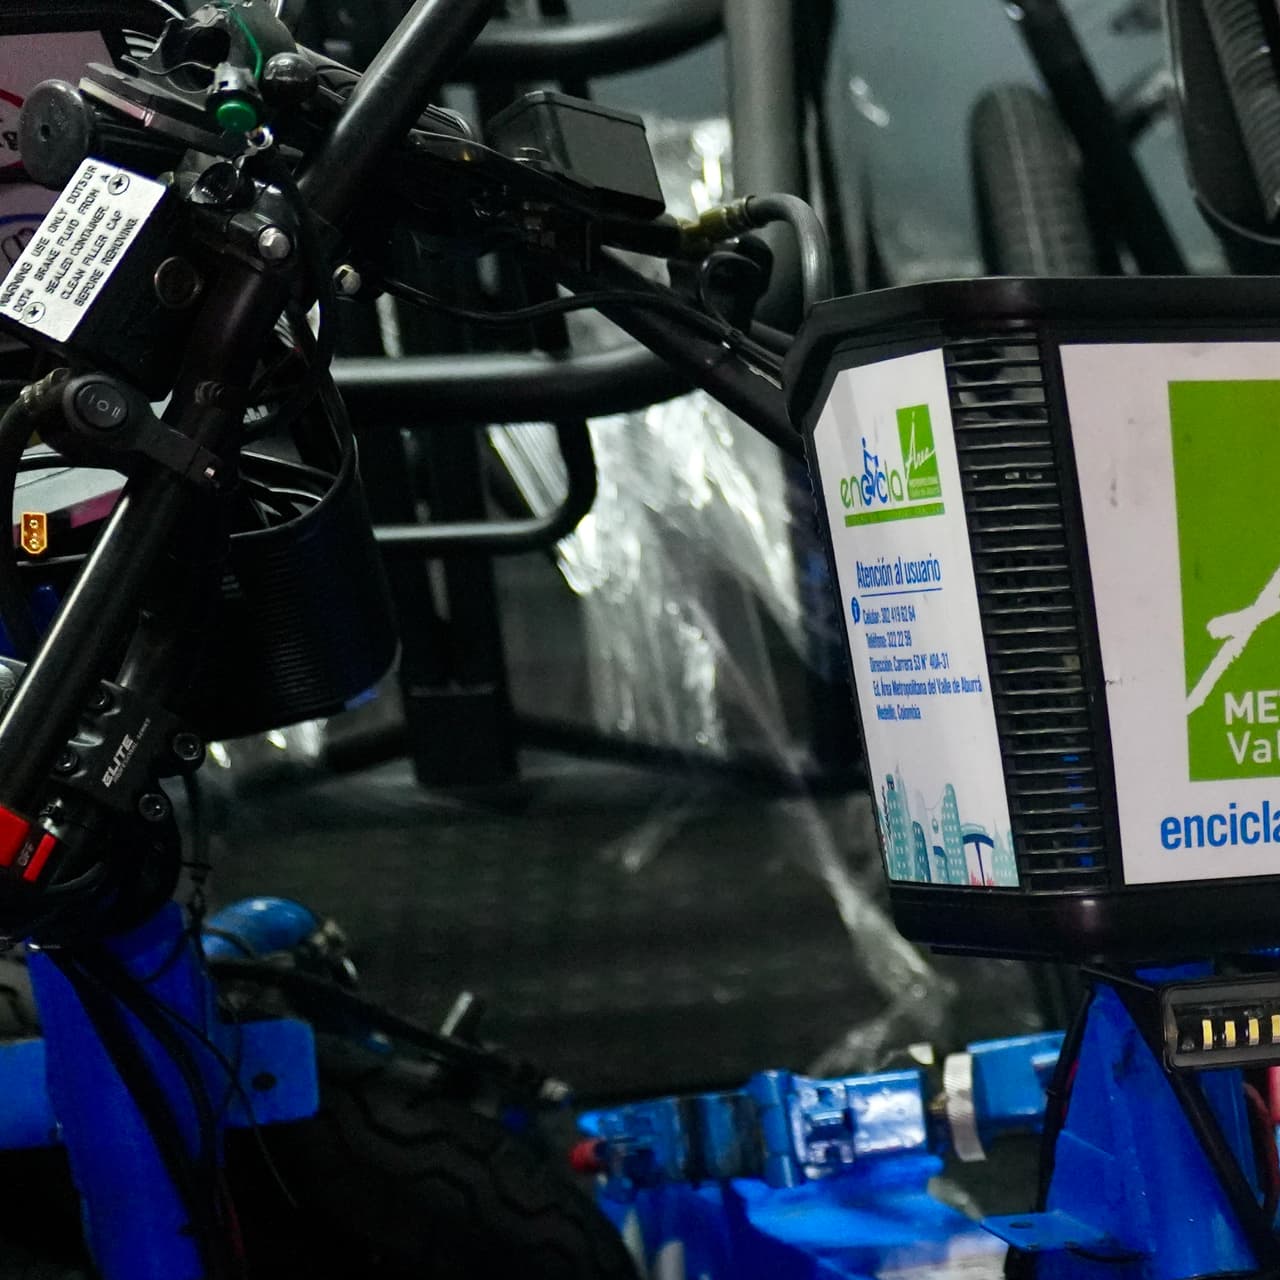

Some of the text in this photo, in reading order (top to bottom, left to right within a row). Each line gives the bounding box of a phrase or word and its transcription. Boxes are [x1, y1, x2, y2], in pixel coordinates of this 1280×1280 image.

[31, 236, 50, 258] USE
[47, 208, 69, 234] ONLY
[33, 247, 60, 282] BRAKE
[56, 218, 80, 248] FLUID
[77, 188, 101, 216] FROM
[60, 210, 124, 301] CLEAN FILLER CAP
[44, 257, 74, 295] SEALED
[74, 270, 105, 307] BEFORE
[856, 552, 942, 589] Atención al usuario
[897, 630, 905, 648] 22
[891, 678, 928, 699] Metropolitana
[927, 678, 937, 697] del
[936, 677, 952, 695] Valle
[952, 677, 961, 694] de
[102, 734, 134, 788] ELITE
[17, 841, 35, 867] OFF
